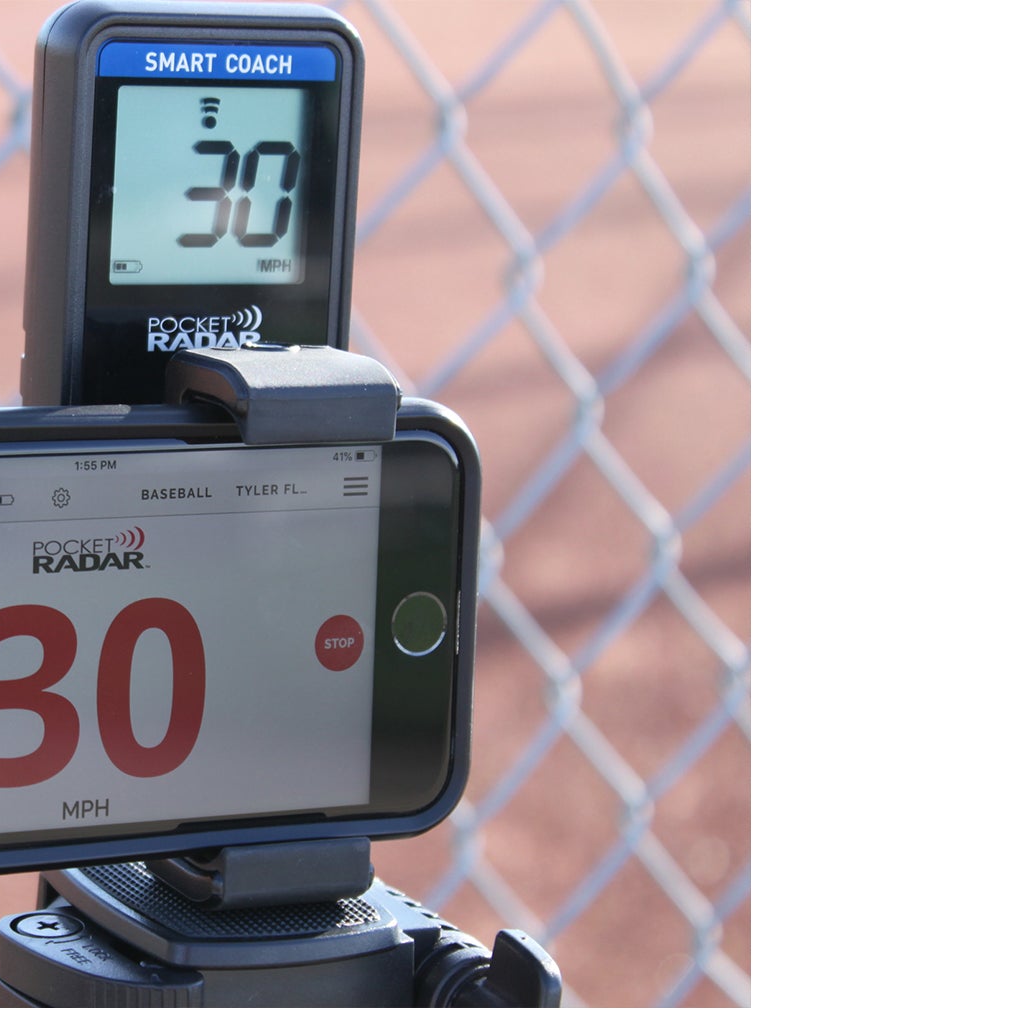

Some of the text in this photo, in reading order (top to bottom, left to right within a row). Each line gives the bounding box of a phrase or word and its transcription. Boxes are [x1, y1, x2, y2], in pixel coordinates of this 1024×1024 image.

[145, 52, 293, 75] SMART COACH
[176, 140, 301, 248] 30
[259, 258, 292, 273] MPH
[148, 316, 231, 334] POCKET
[332, 451, 353, 462] 41%
[74, 460, 117, 472] 1:55 PM
[141, 486, 212, 501] BASEBALL
[236, 484, 279, 497] TYLER
[33, 537, 114, 556] POCKET
[32, 551, 144, 574] RADAR
[323, 636, 356, 650] STOP
[62, 798, 110, 821] MPH
